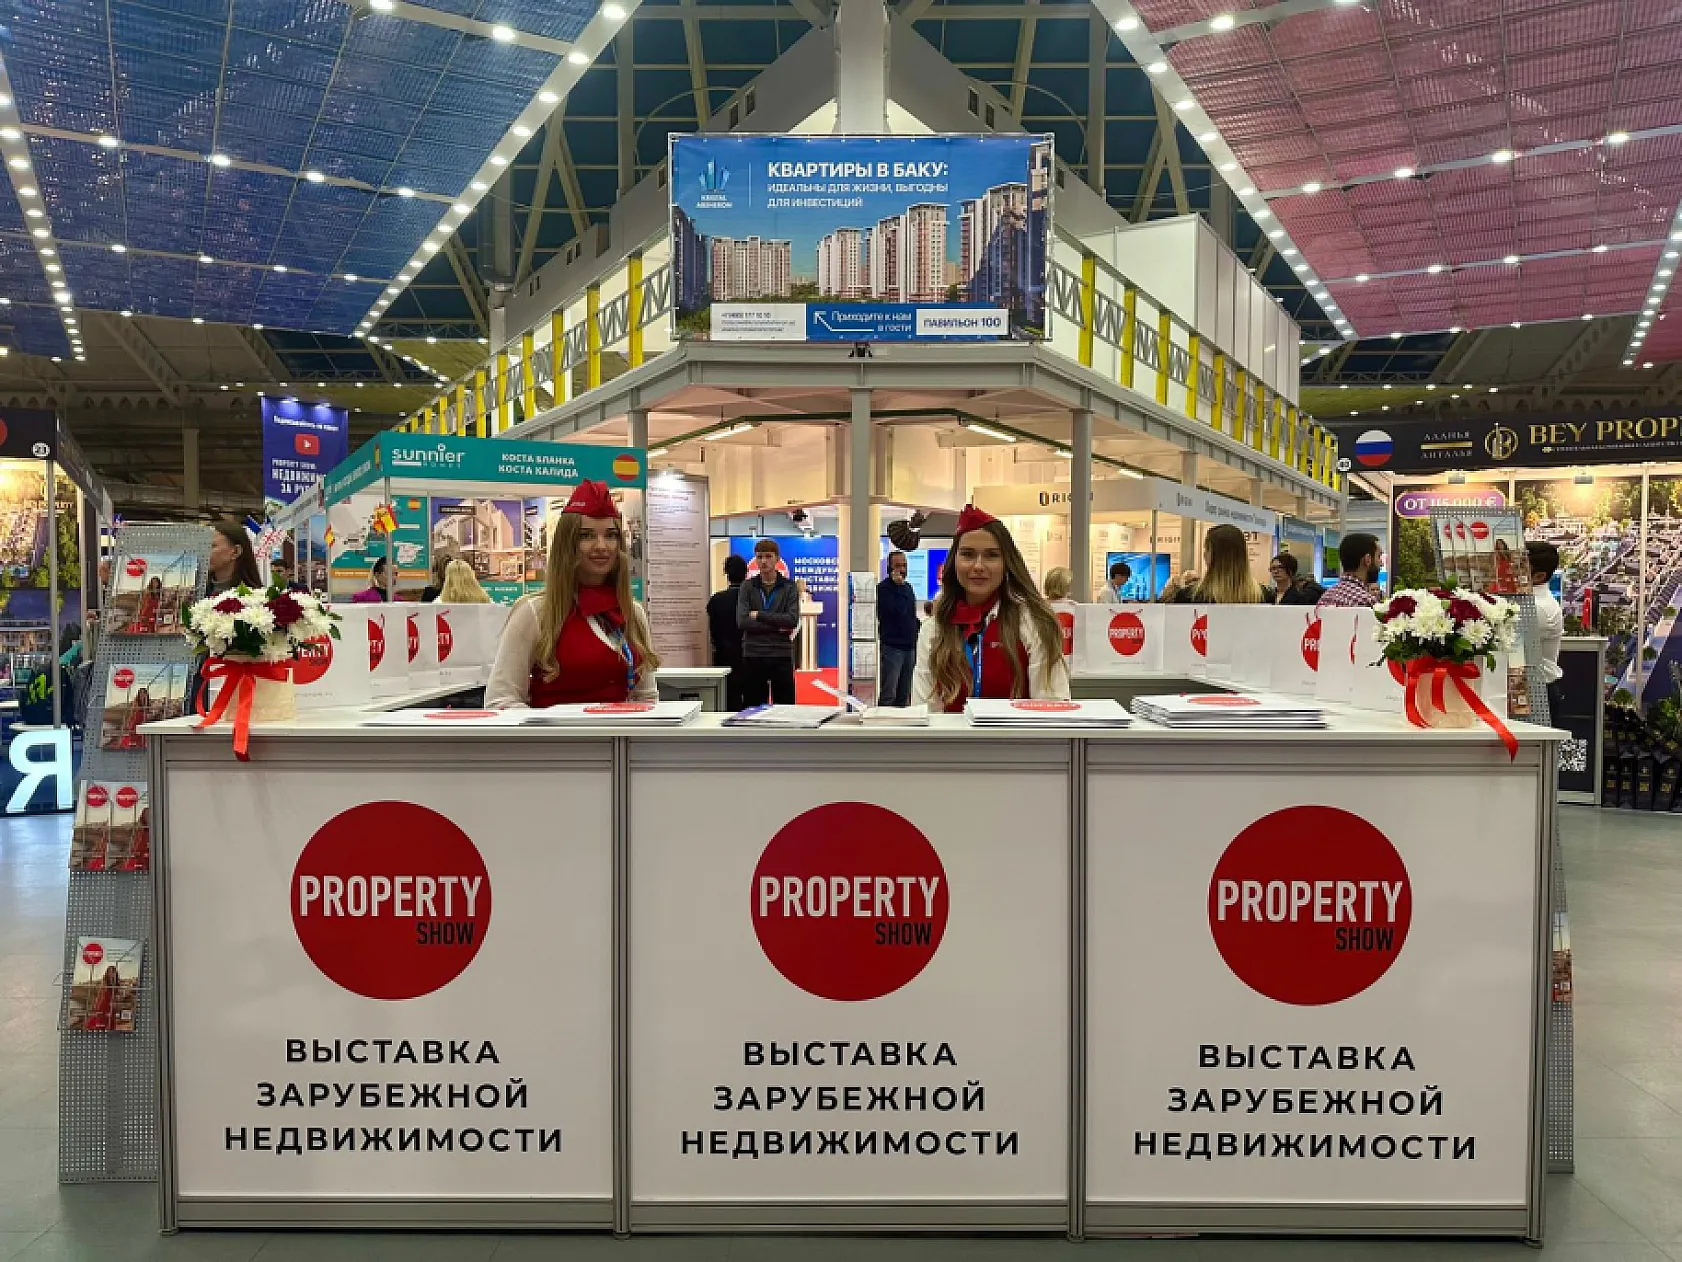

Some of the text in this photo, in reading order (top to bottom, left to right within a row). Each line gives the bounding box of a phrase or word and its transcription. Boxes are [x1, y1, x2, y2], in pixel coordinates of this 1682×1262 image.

[768, 162, 949, 178] КВАРТИРЫ В БАКУ:
[767, 183, 826, 194] ИДЕАЛЬНЫ
[827, 183, 850, 194] ДЛЯ
[895, 183, 949, 193] ВЫГОДНЫ
[767, 196, 864, 209] ДЛЯ ИНВЕСТИЦИЙ
[832, 311, 884, 322] Приходите
[924, 317, 1001, 329] ПАВИЛЬОН 100
[1528, 421, 1588, 445] BEY
[392, 443, 466, 464] sunnier
[502, 453, 575, 466] КОСТА БЛАНКА
[498, 465, 579, 479] КОСТА КАЛИДА
[299, 874, 483, 918] PROPERTY
[758, 875, 941, 918] PROPERTY
[1217, 880, 1405, 924] PROPERTY
[416, 921, 475, 946] SHOW
[875, 921, 933, 946] SHOW
[1335, 926, 1395, 952] SHOW
[286, 1038, 500, 1065] ВЫСТАВКА
[744, 1039, 958, 1066] ВЫСТАВКА
[1199, 1043, 1416, 1072] ВЫСТАВКА
[256, 1077, 528, 1109] ЗАРУБЕЖНОЙ
[713, 1079, 985, 1112] ЗАРУБЕЖНОЙ
[1167, 1084, 1442, 1116] ЗАРУБЕЖНОЙ
[225, 1126, 562, 1156] НЕДВИЖИМОСТИ
[682, 1130, 1019, 1160] НЕДВИЖИМОСТИ
[1134, 1131, 1475, 1162] НЕДВИЖИМОСТИ
